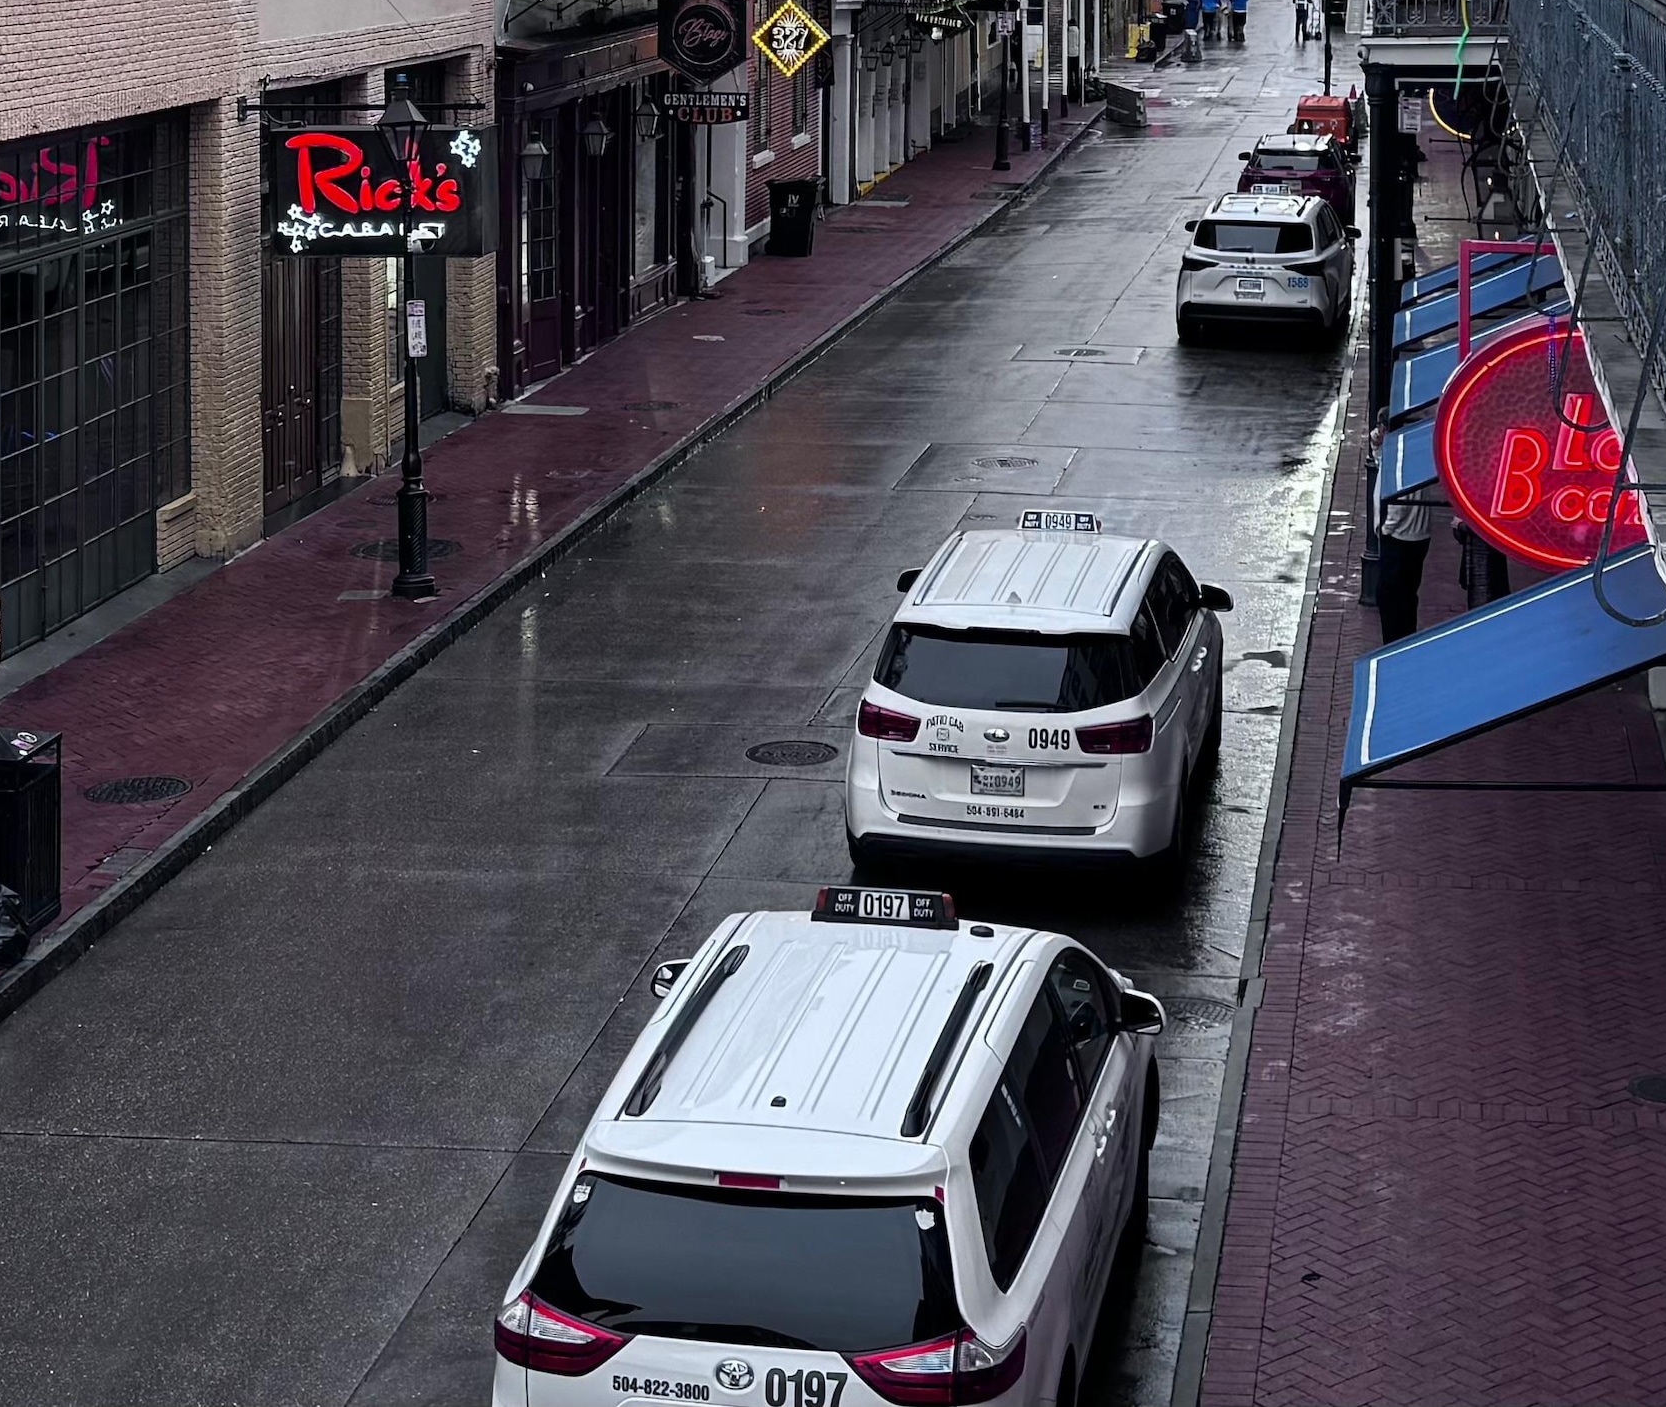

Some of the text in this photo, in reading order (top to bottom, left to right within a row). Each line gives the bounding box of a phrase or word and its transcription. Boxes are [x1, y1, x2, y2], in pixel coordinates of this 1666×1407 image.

[772, 27, 809, 50] 327
[664, 93, 747, 107] GENTLEMEN'S
[677, 107, 733, 122] CLUB
[285, 132, 461, 214] Rick's
[318, 222, 446, 238] CABAET
[1045, 514, 1072, 529] 0949
[1028, 728, 1070, 751] 0949
[994, 775, 1021, 789] 0949
[835, 903, 934, 918] DUTY DUTY
[838, 893, 931, 918] OFF 0197 OFF
[612, 1367, 849, 1407] 504-822-3800 0197
